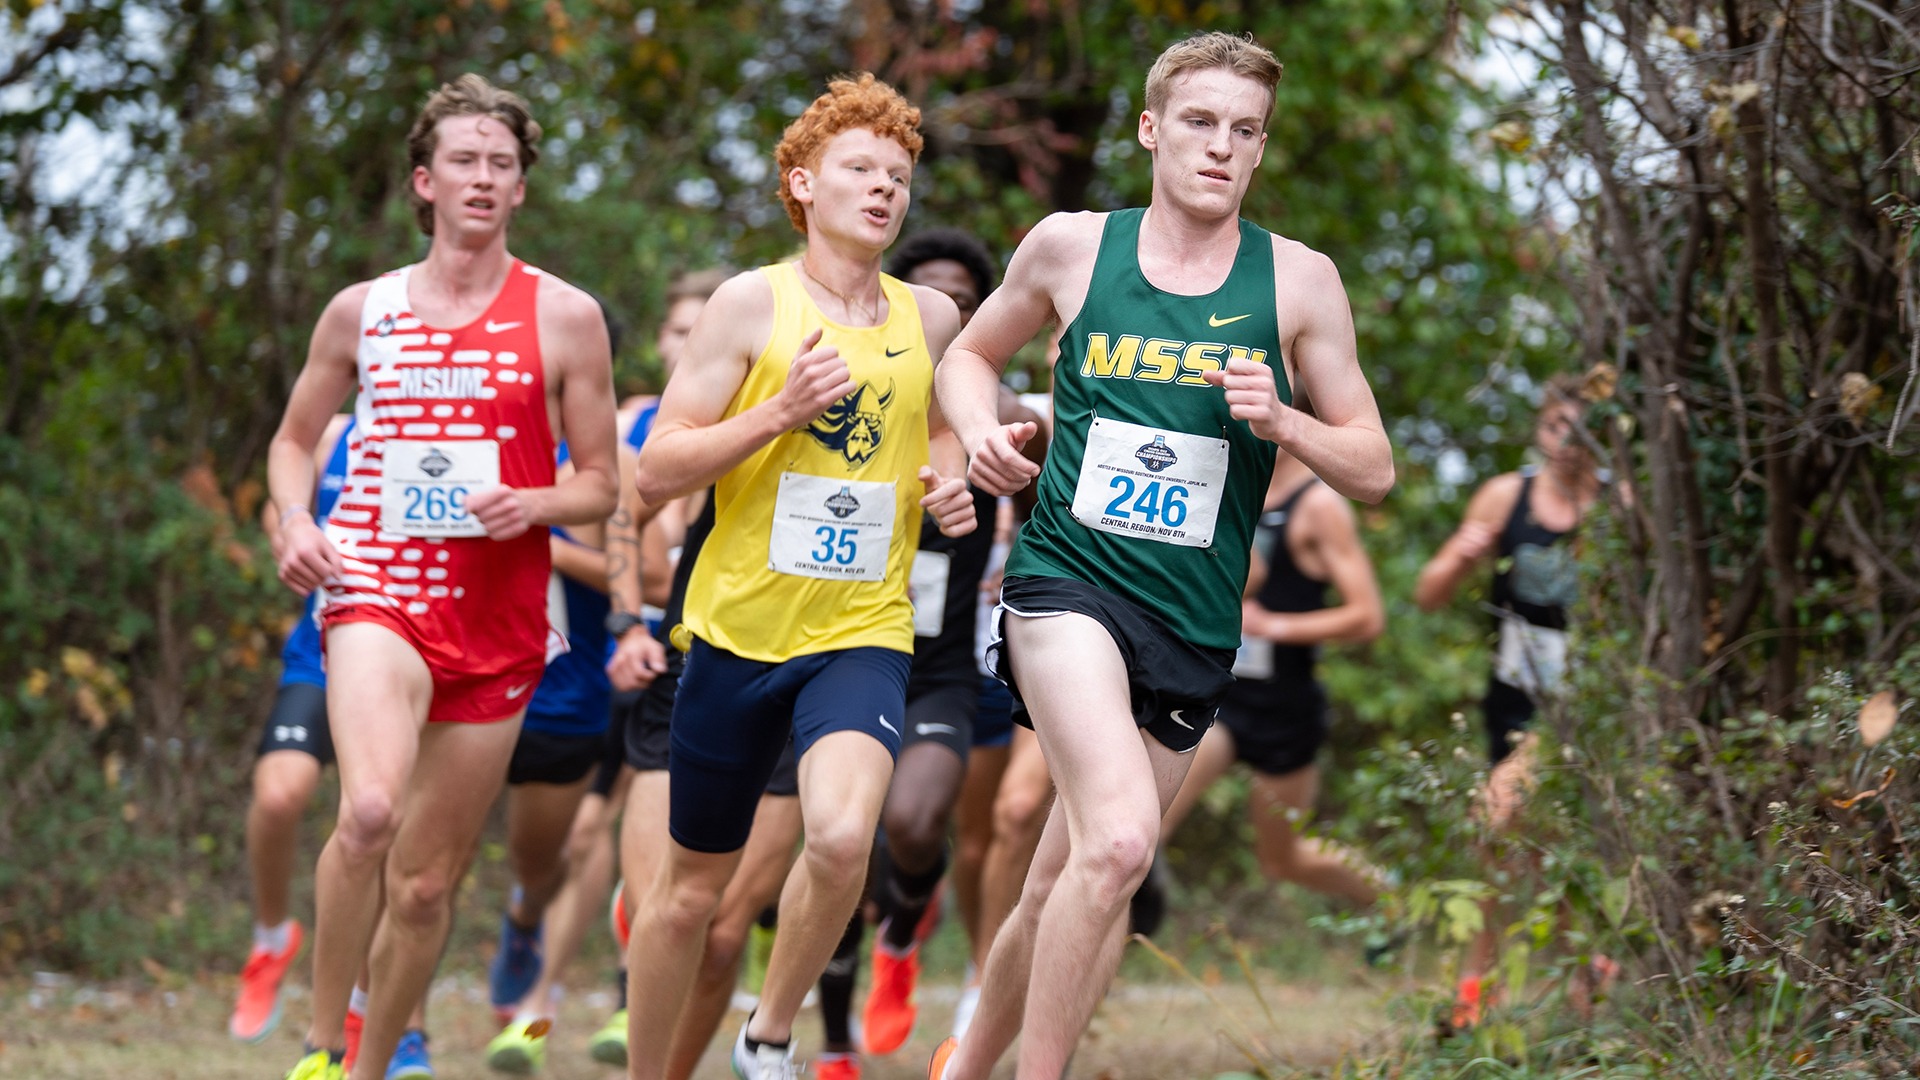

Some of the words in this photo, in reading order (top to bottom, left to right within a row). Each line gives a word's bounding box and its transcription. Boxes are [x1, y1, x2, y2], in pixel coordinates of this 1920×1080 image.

[400, 366, 483, 399] MSUM
[1136, 451, 1177, 464] CHAMPIONSHIPS
[404, 487, 469, 520] 269
[1104, 475, 1189, 527] 246
[1100, 517, 1129, 530] CENTRAL
[1157, 527, 1173, 536] NOV
[1172, 530, 1186, 538] 8TH
[811, 525, 859, 565] 35
[795, 561, 820, 571] CENTRAL
